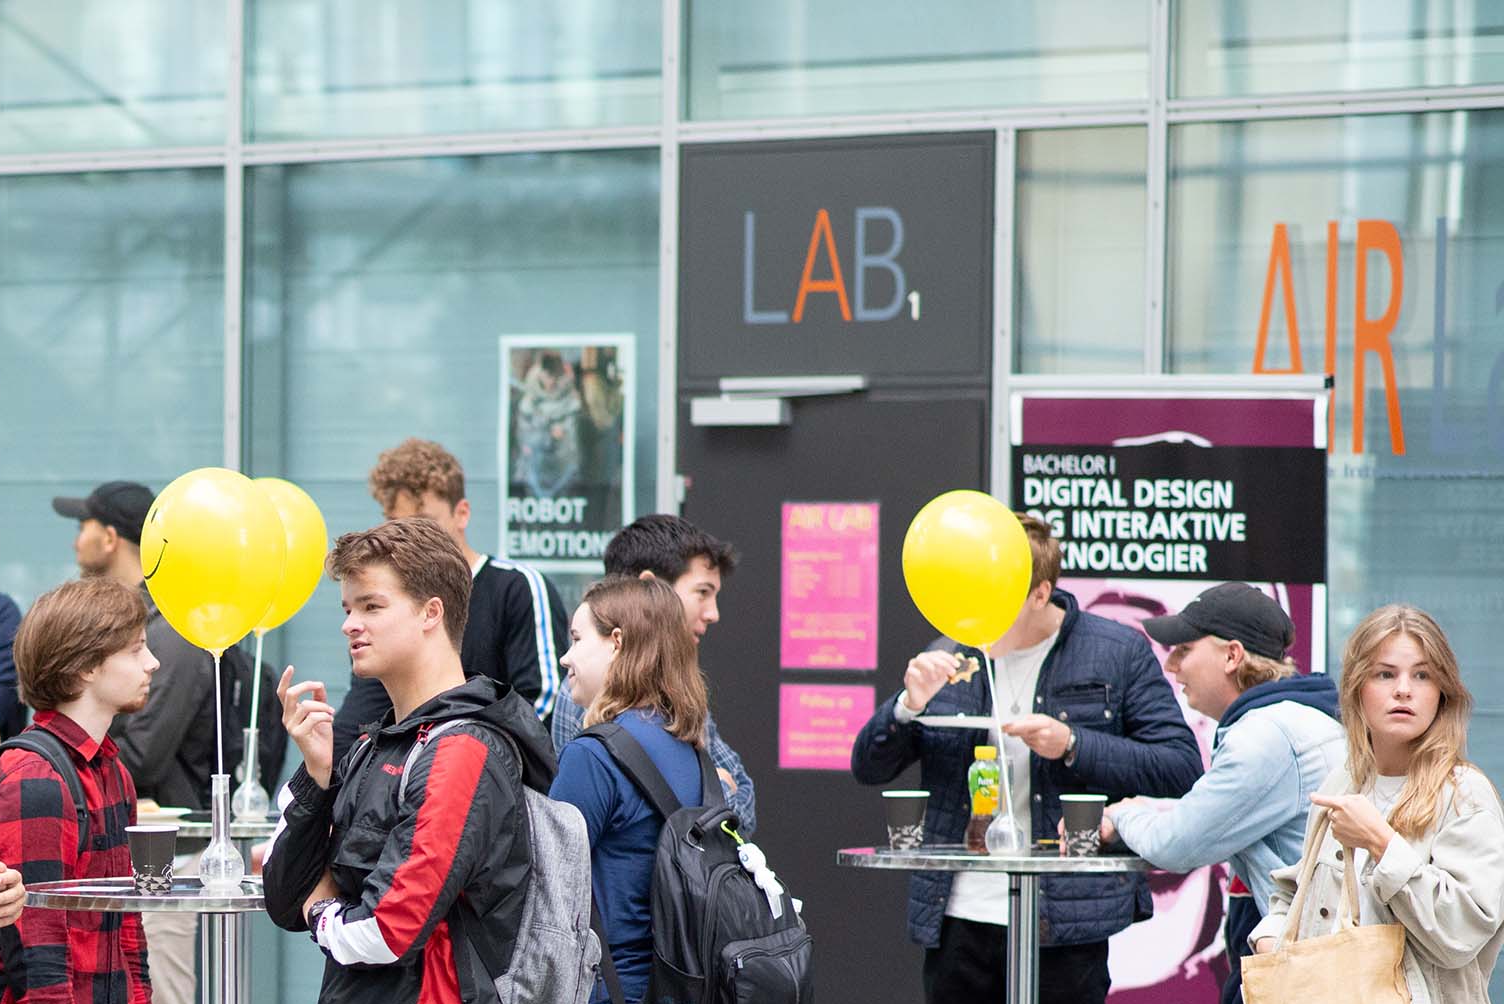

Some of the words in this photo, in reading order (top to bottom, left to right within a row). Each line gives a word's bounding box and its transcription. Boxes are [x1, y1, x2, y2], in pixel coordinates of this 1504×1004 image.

[744, 207, 905, 323] LAB
[907, 290, 920, 321] 1
[1252, 219, 1406, 456] AIR
[1023, 454, 1105, 475] BACHELOR
[1024, 478, 1127, 507] DIGITAL
[1133, 480, 1233, 509] DESIGN
[506, 497, 588, 524] ROBOT
[1072, 510, 1246, 542] INTERAKTIVE
[507, 530, 616, 557] EMOTION
